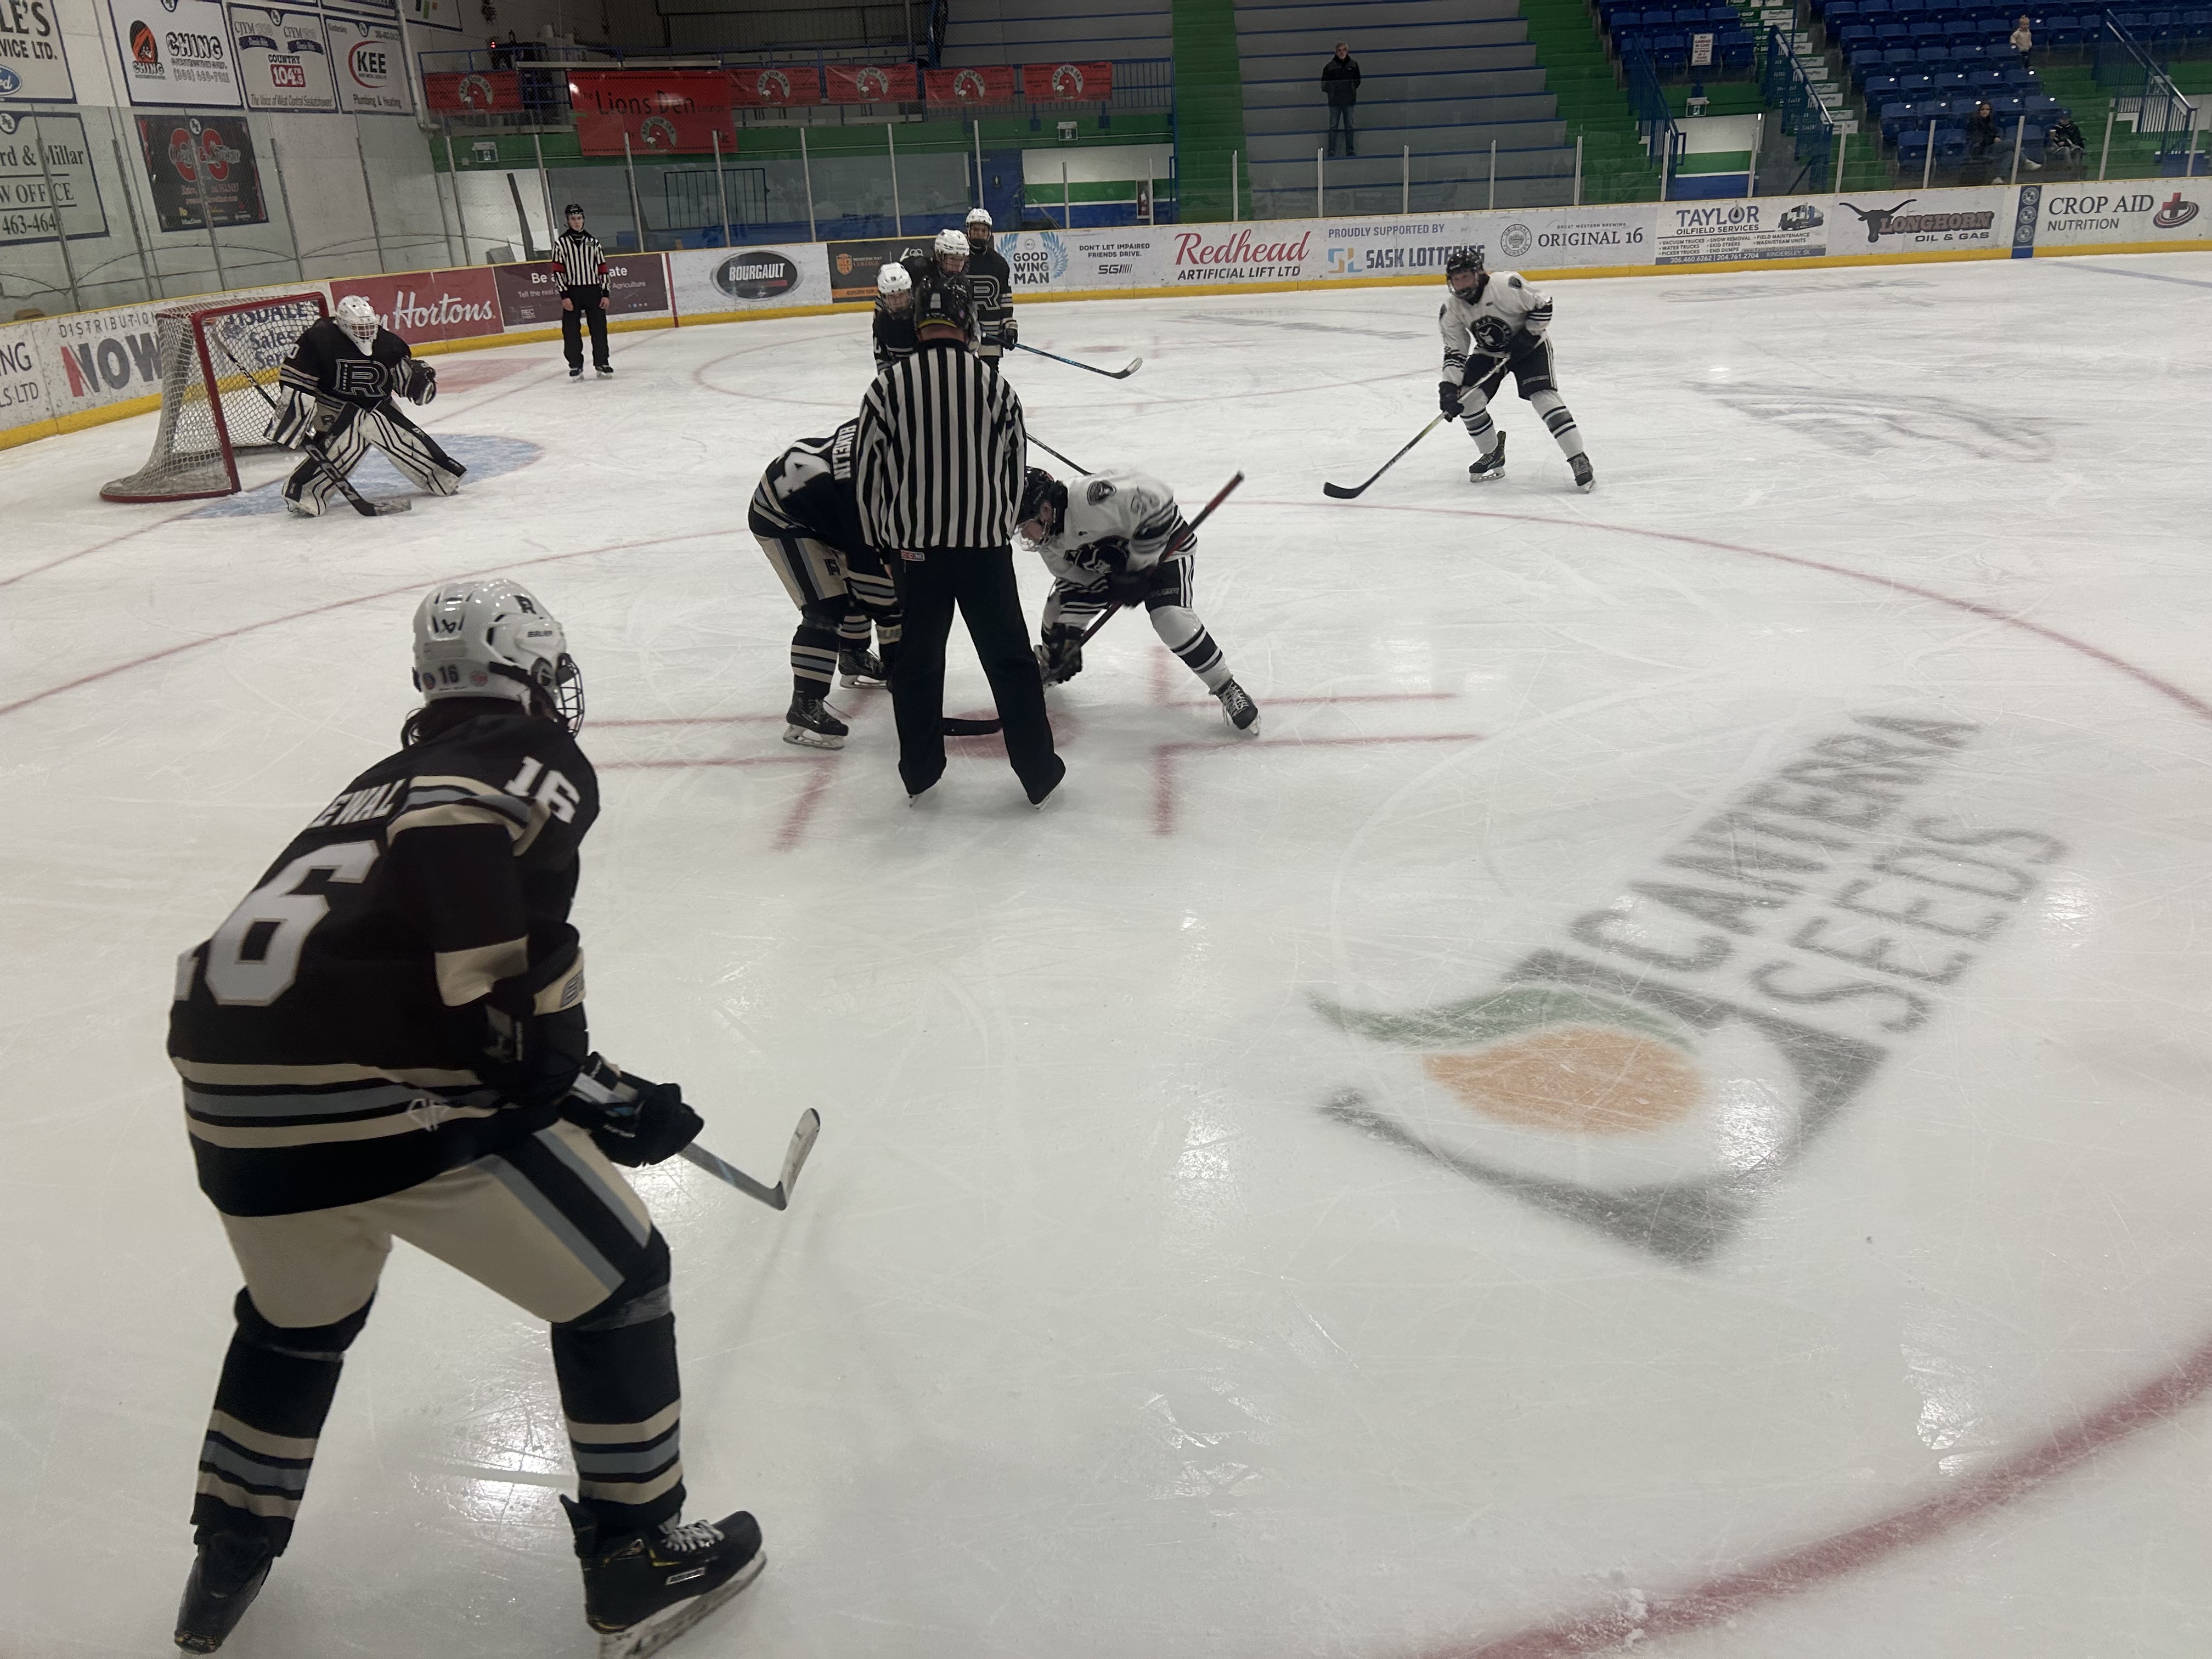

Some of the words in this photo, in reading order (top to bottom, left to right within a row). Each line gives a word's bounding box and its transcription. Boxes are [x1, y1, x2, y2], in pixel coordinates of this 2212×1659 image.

[31, 41, 58, 60] LTD.
[166, 31, 223, 60] CHING
[132, 60, 165, 75] CHING
[268, 54, 300, 64] COUNTRY
[357, 51, 386, 74] KEE
[277, 95, 288, 106] West
[596, 89, 653, 115] Lions
[657, 89, 696, 115] Den
[22, 145, 37, 166] &
[16, 182, 74, 203] OFFCE
[2049, 196, 2108, 215] CROP
[2113, 195, 2154, 212] AID
[3, 212, 57, 235] 463-464
[1676, 206, 1759, 227] TAYLOR
[1878, 211, 1995, 235] LONGHORN
[2047, 218, 2119, 231] NUTRITION
[1328, 227, 1371, 238] PROUDLY
[1373, 224, 1429, 236] SUPPORTED
[1432, 223, 1444, 233] BY
[1504, 225, 1528, 236] ORIGINAL
[1538, 231, 1621, 247] ORIGINAL
[1626, 227, 1643, 243] 16
[1718, 224, 1759, 233] SERVICES
[1959, 232, 1989, 240] GAS
[1013, 252, 1048, 262] GOOD
[1174, 229, 1311, 265] Redhead
[1014, 262, 1049, 272] WING
[1366, 249, 1404, 269] SASK
[531, 273, 548, 284] Be
[729, 263, 786, 282] BOURGAULT
[1014, 272, 1049, 284] MAN
[1178, 268, 1245, 280] ARTIFICIAL
[1248, 267, 1275, 278] LIFT
[1278, 266, 1300, 277] LTD
[612, 281, 646, 290] Agriculture
[393, 291, 494, 330] Hortons
[250, 330, 296, 351] Sales
[255, 351, 288, 370] Ser
[334, 359, 388, 397] R
[14, 382, 38, 403] LTD
[832, 425, 857, 481] HAMELIN
[439, 665, 460, 684] 16
[505, 755, 580, 824] 16
[1568, 715, 1982, 973] CANTERRA
[1750, 816, 2069, 1034] SEEDS
